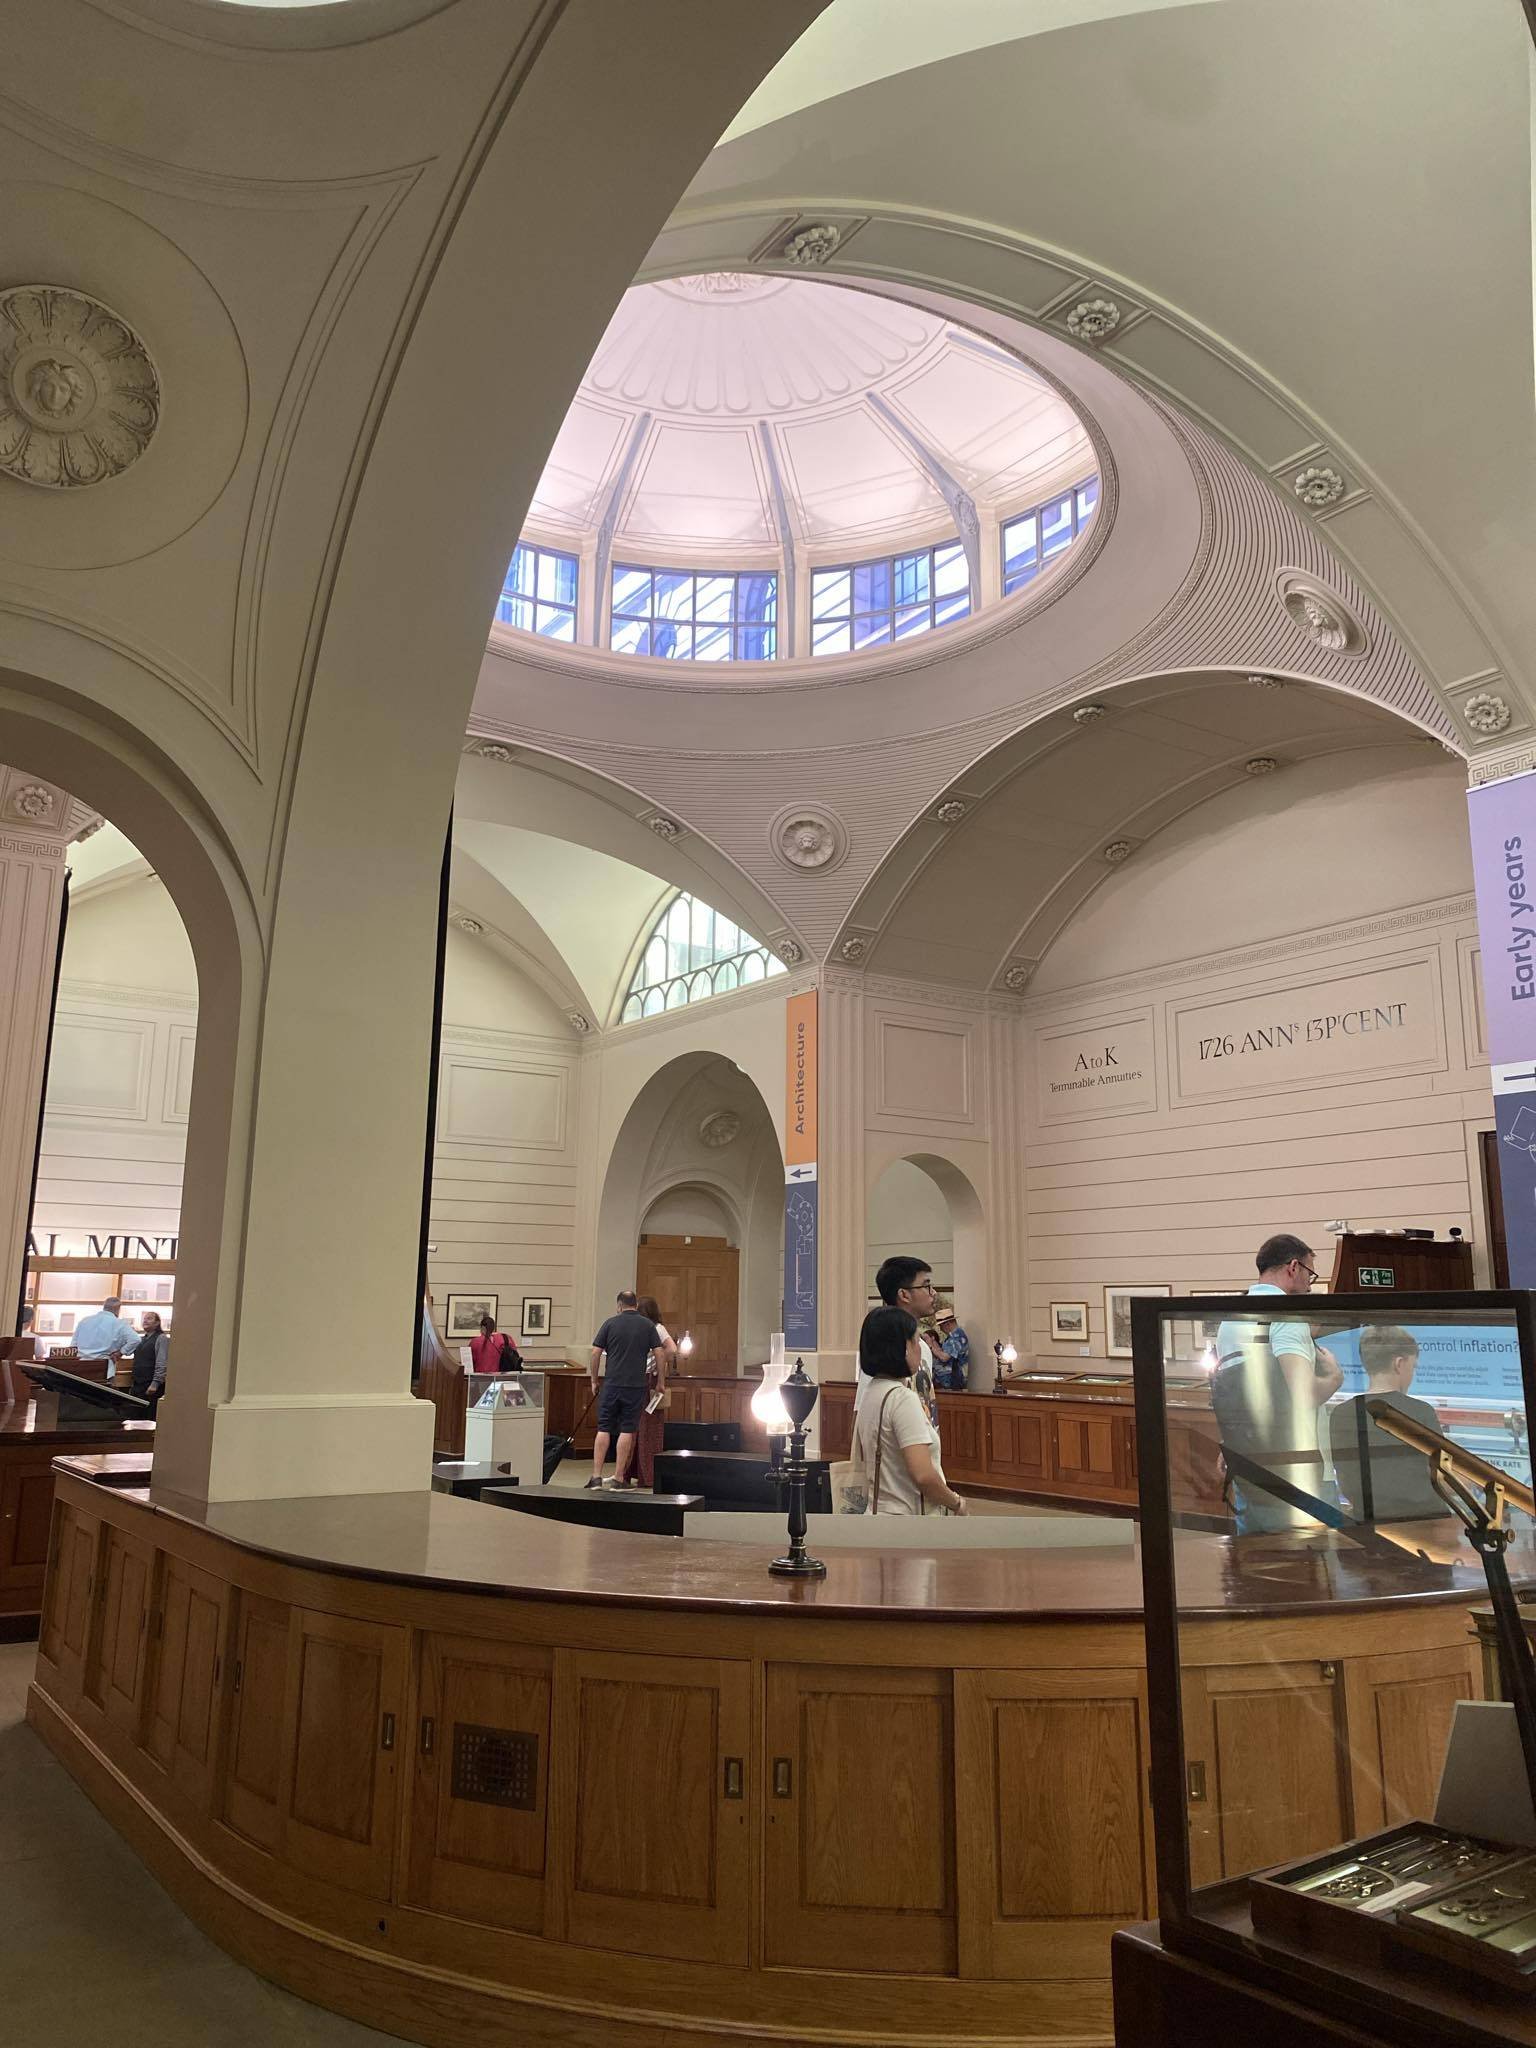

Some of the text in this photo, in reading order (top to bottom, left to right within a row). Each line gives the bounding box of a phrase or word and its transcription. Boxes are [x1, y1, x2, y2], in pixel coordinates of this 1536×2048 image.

[1504, 836, 1536, 1001] Early years
[1074, 1046, 1118, 1071] A to K
[1199, 1034, 1234, 1061] 1726
[795, 1022, 805, 1135] Architecture
[1049, 1070, 1142, 1093] Terminable Annuities
[50, 1347, 78, 1358] SHOP
[1417, 1339, 1519, 1353] control inflation?
